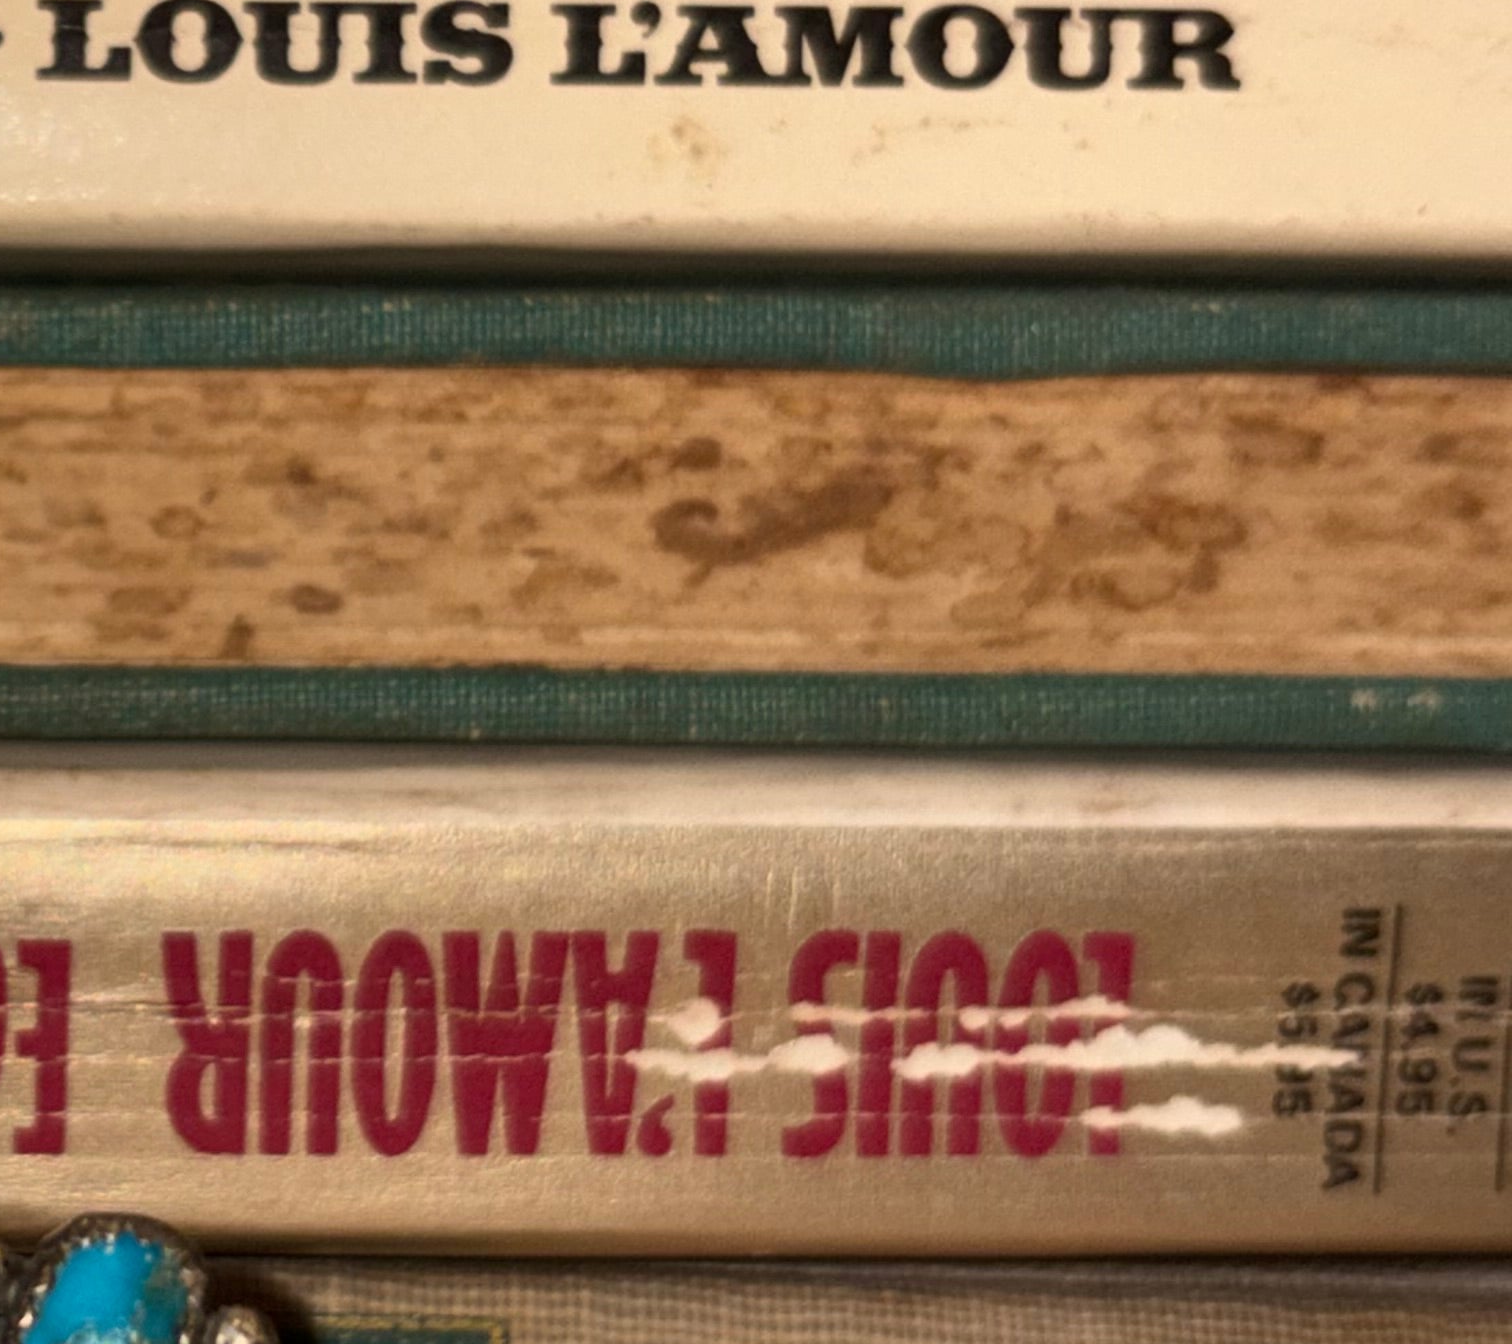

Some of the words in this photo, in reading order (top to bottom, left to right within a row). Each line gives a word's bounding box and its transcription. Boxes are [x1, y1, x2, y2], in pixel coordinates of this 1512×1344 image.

[550, 0, 1243, 93] L'AMOUR
[1339, 907, 1382, 958] IN
[161, 928, 737, 1158] L'AMOUR
[781, 928, 1136, 1158] LOUIS
[1395, 981, 1445, 1117] $4.95
[1455, 974, 1500, 1022] IN
